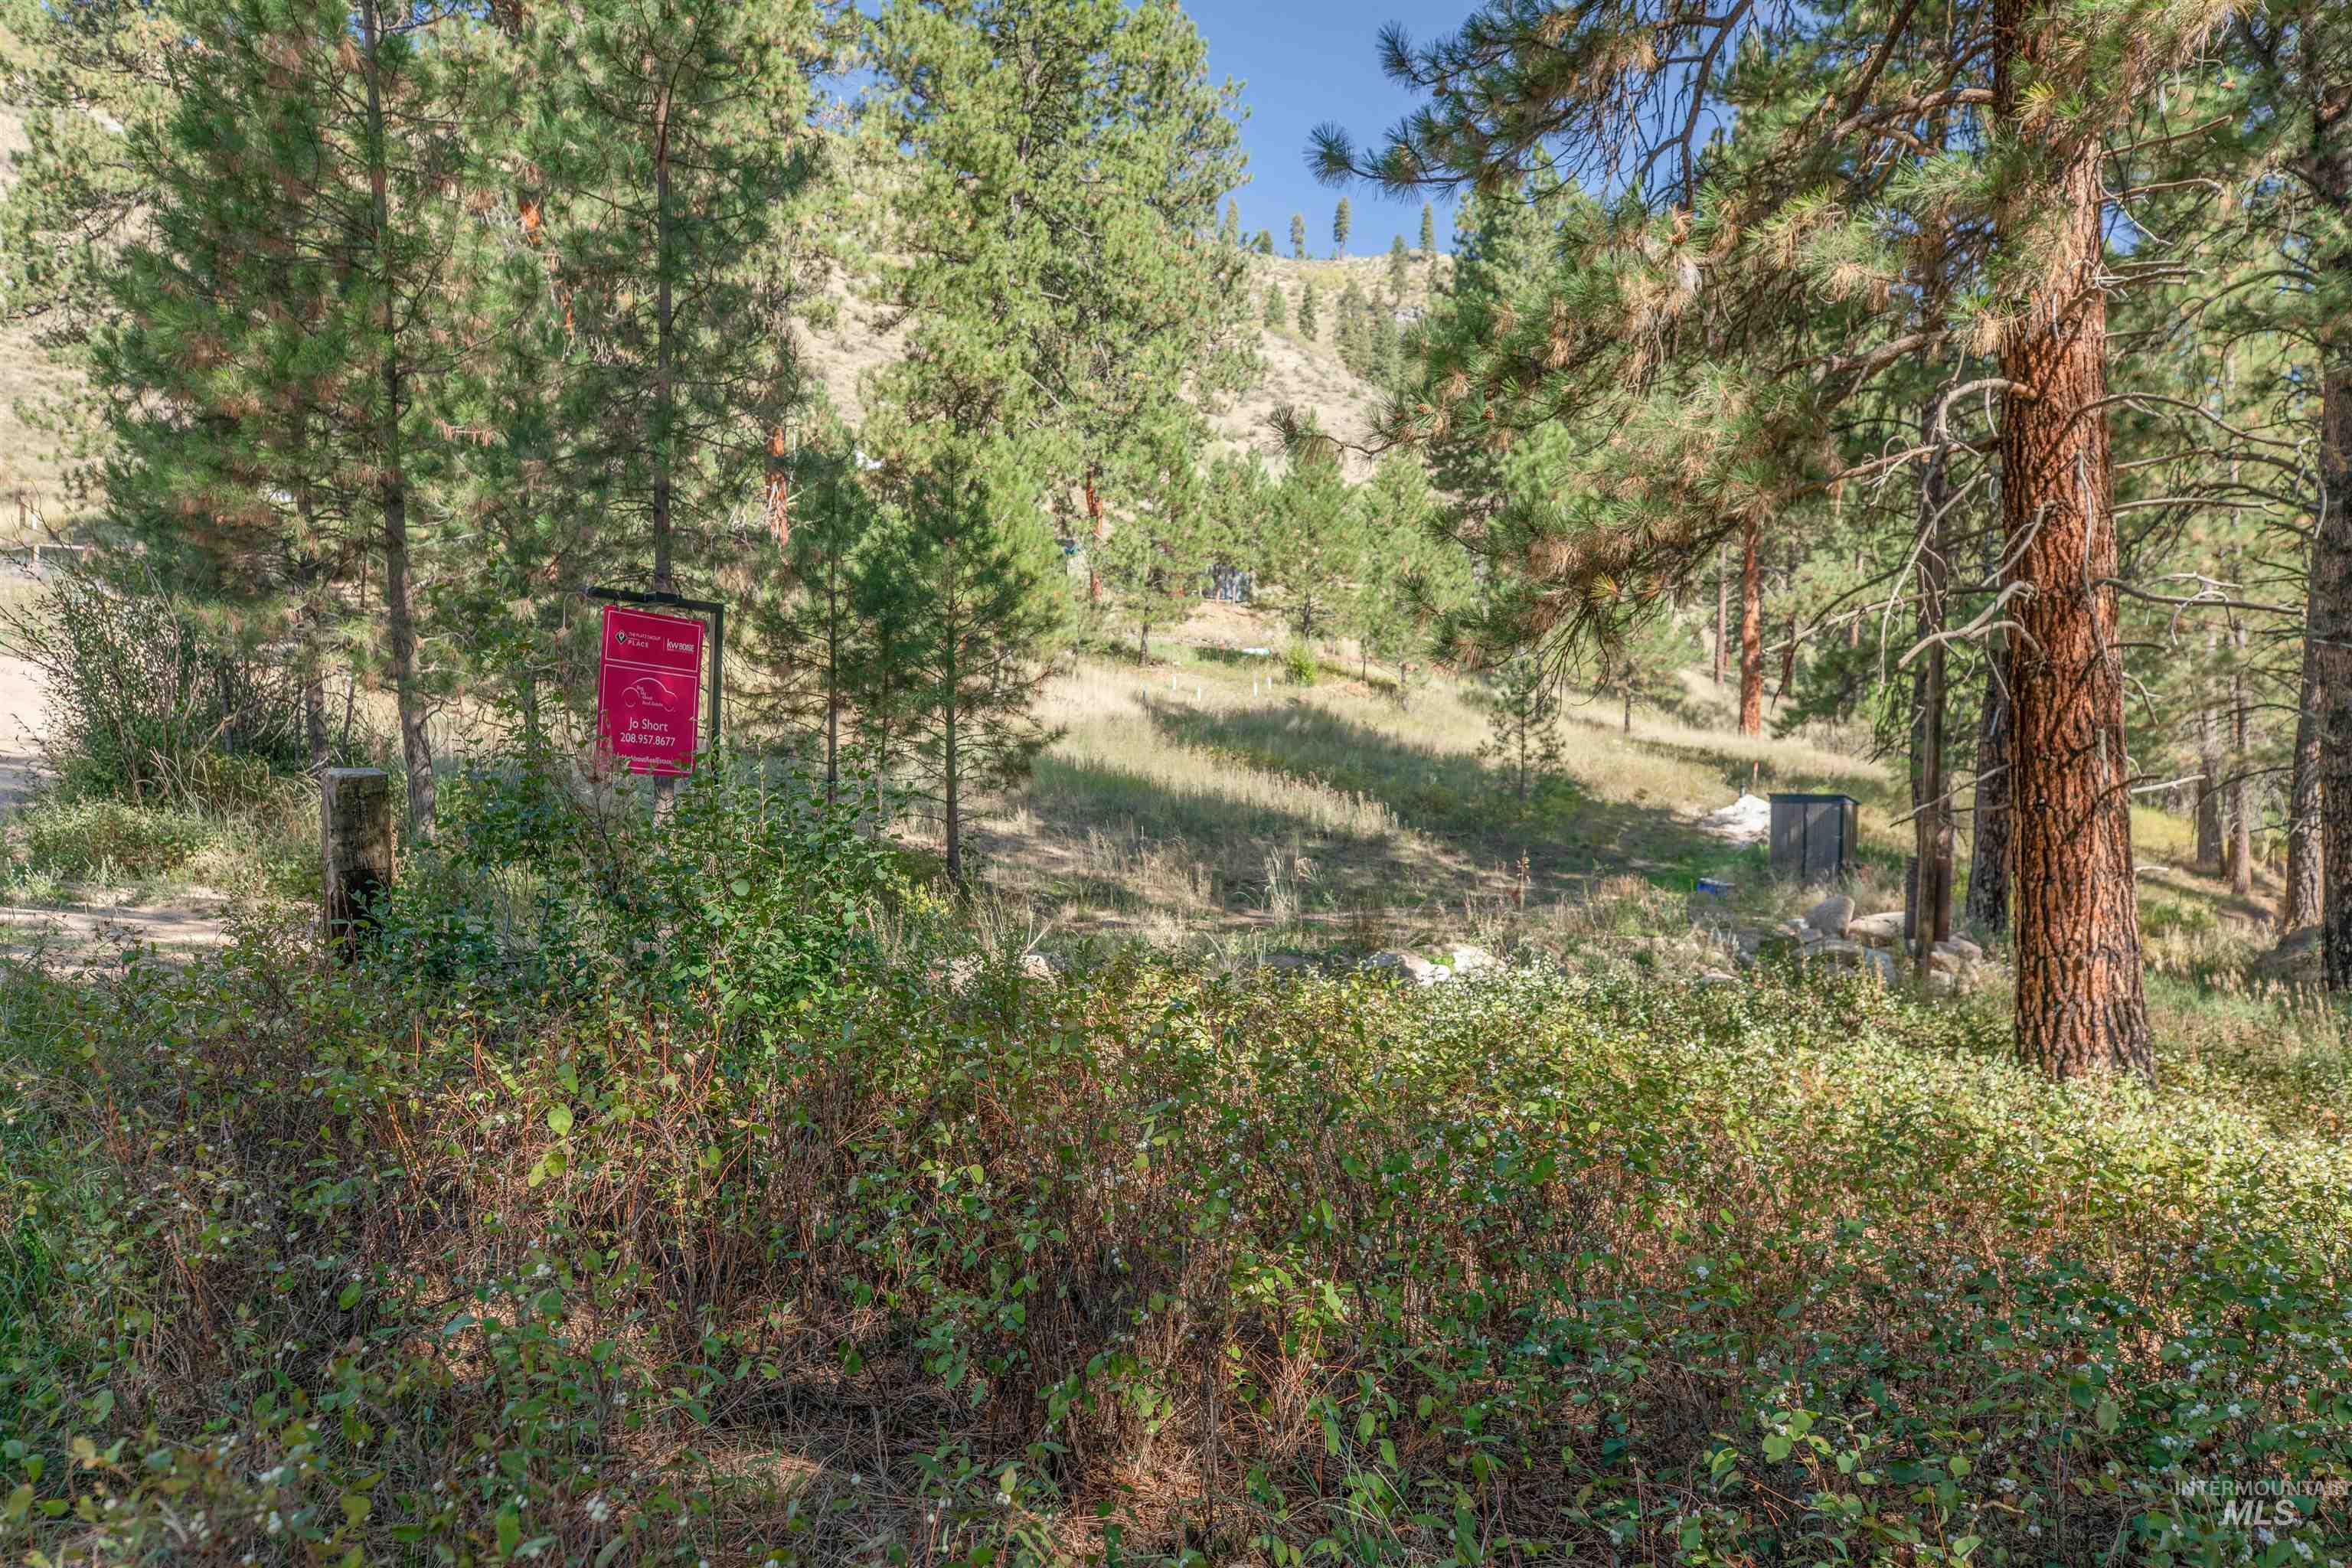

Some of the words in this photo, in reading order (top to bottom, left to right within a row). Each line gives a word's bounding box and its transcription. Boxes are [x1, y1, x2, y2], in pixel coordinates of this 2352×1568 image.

[628, 639, 649, 648] PLACE
[629, 717, 639, 730] Jo
[642, 718, 668, 732] Short
[619, 732, 675, 747] 208.957.8677
